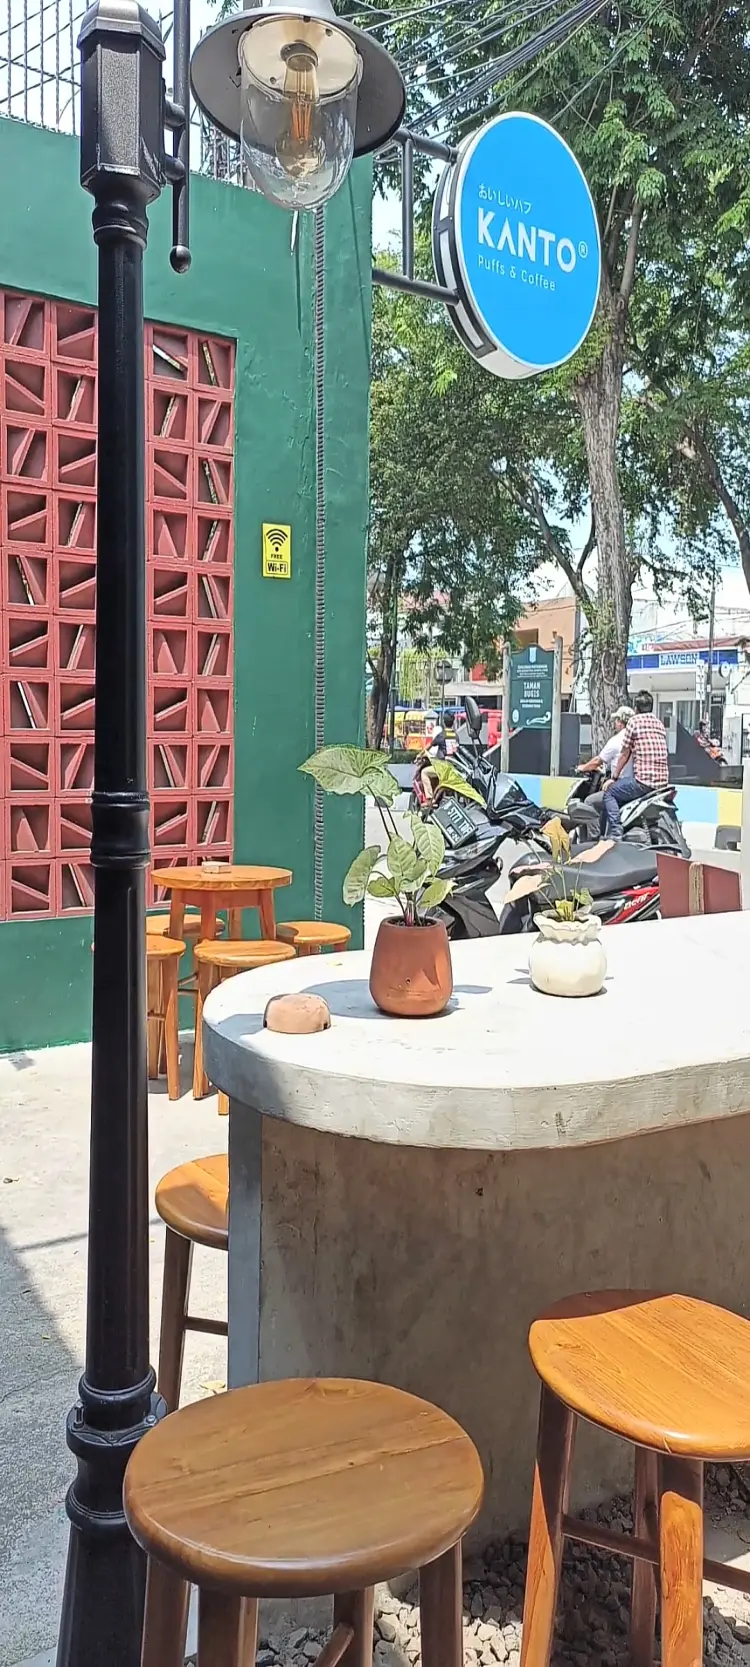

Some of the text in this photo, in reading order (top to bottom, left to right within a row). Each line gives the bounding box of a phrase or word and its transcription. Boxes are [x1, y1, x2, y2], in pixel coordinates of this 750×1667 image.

[478, 254, 556, 291] Puffs & Coffee
[267, 562, 287, 573] Wi-Fi
[660, 653, 698, 666] LAWSON
[523, 681, 541, 690] TAMAN
